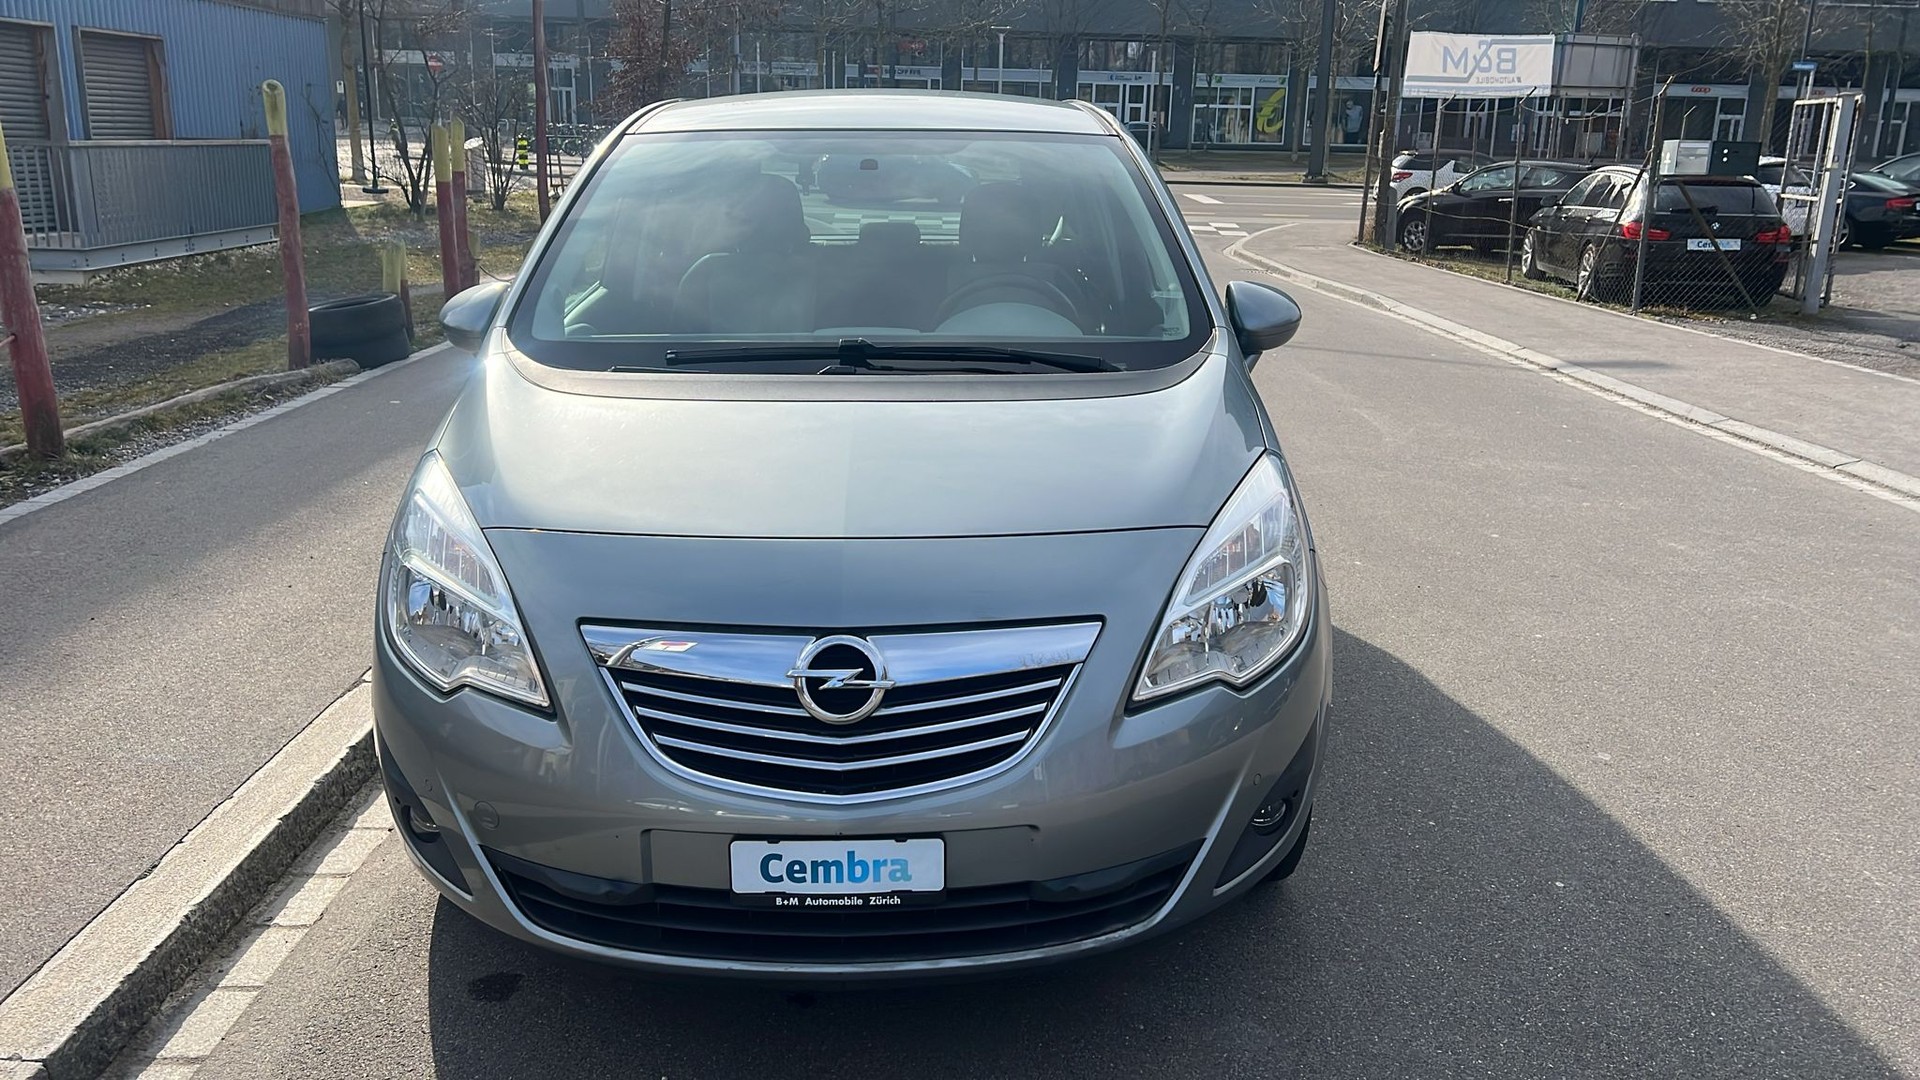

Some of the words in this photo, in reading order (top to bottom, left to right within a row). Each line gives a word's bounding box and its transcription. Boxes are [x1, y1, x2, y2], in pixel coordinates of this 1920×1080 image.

[760, 850, 912, 884] Cembra
[775, 897, 799, 906] B+M
[804, 896, 863, 906] Automobile
[869, 895, 901, 905] Zürich
